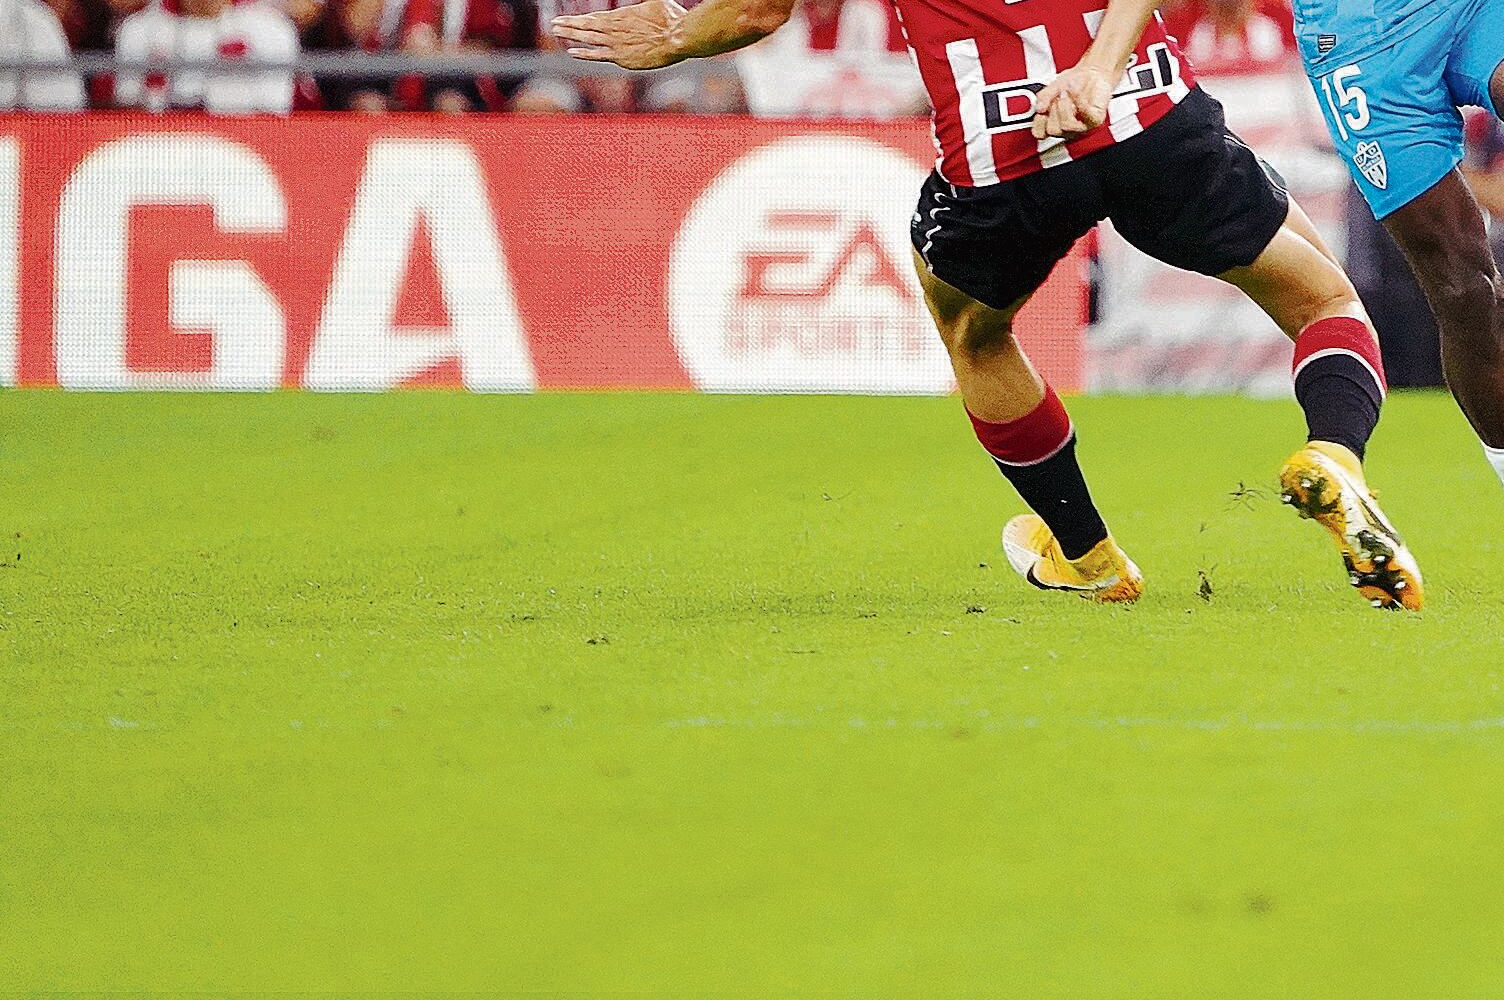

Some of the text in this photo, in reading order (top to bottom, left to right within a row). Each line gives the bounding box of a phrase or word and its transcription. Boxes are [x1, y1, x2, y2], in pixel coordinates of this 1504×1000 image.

[1321, 63, 1371, 142] 15
[0, 133, 535, 392] GA
[736, 211, 916, 302] EA
